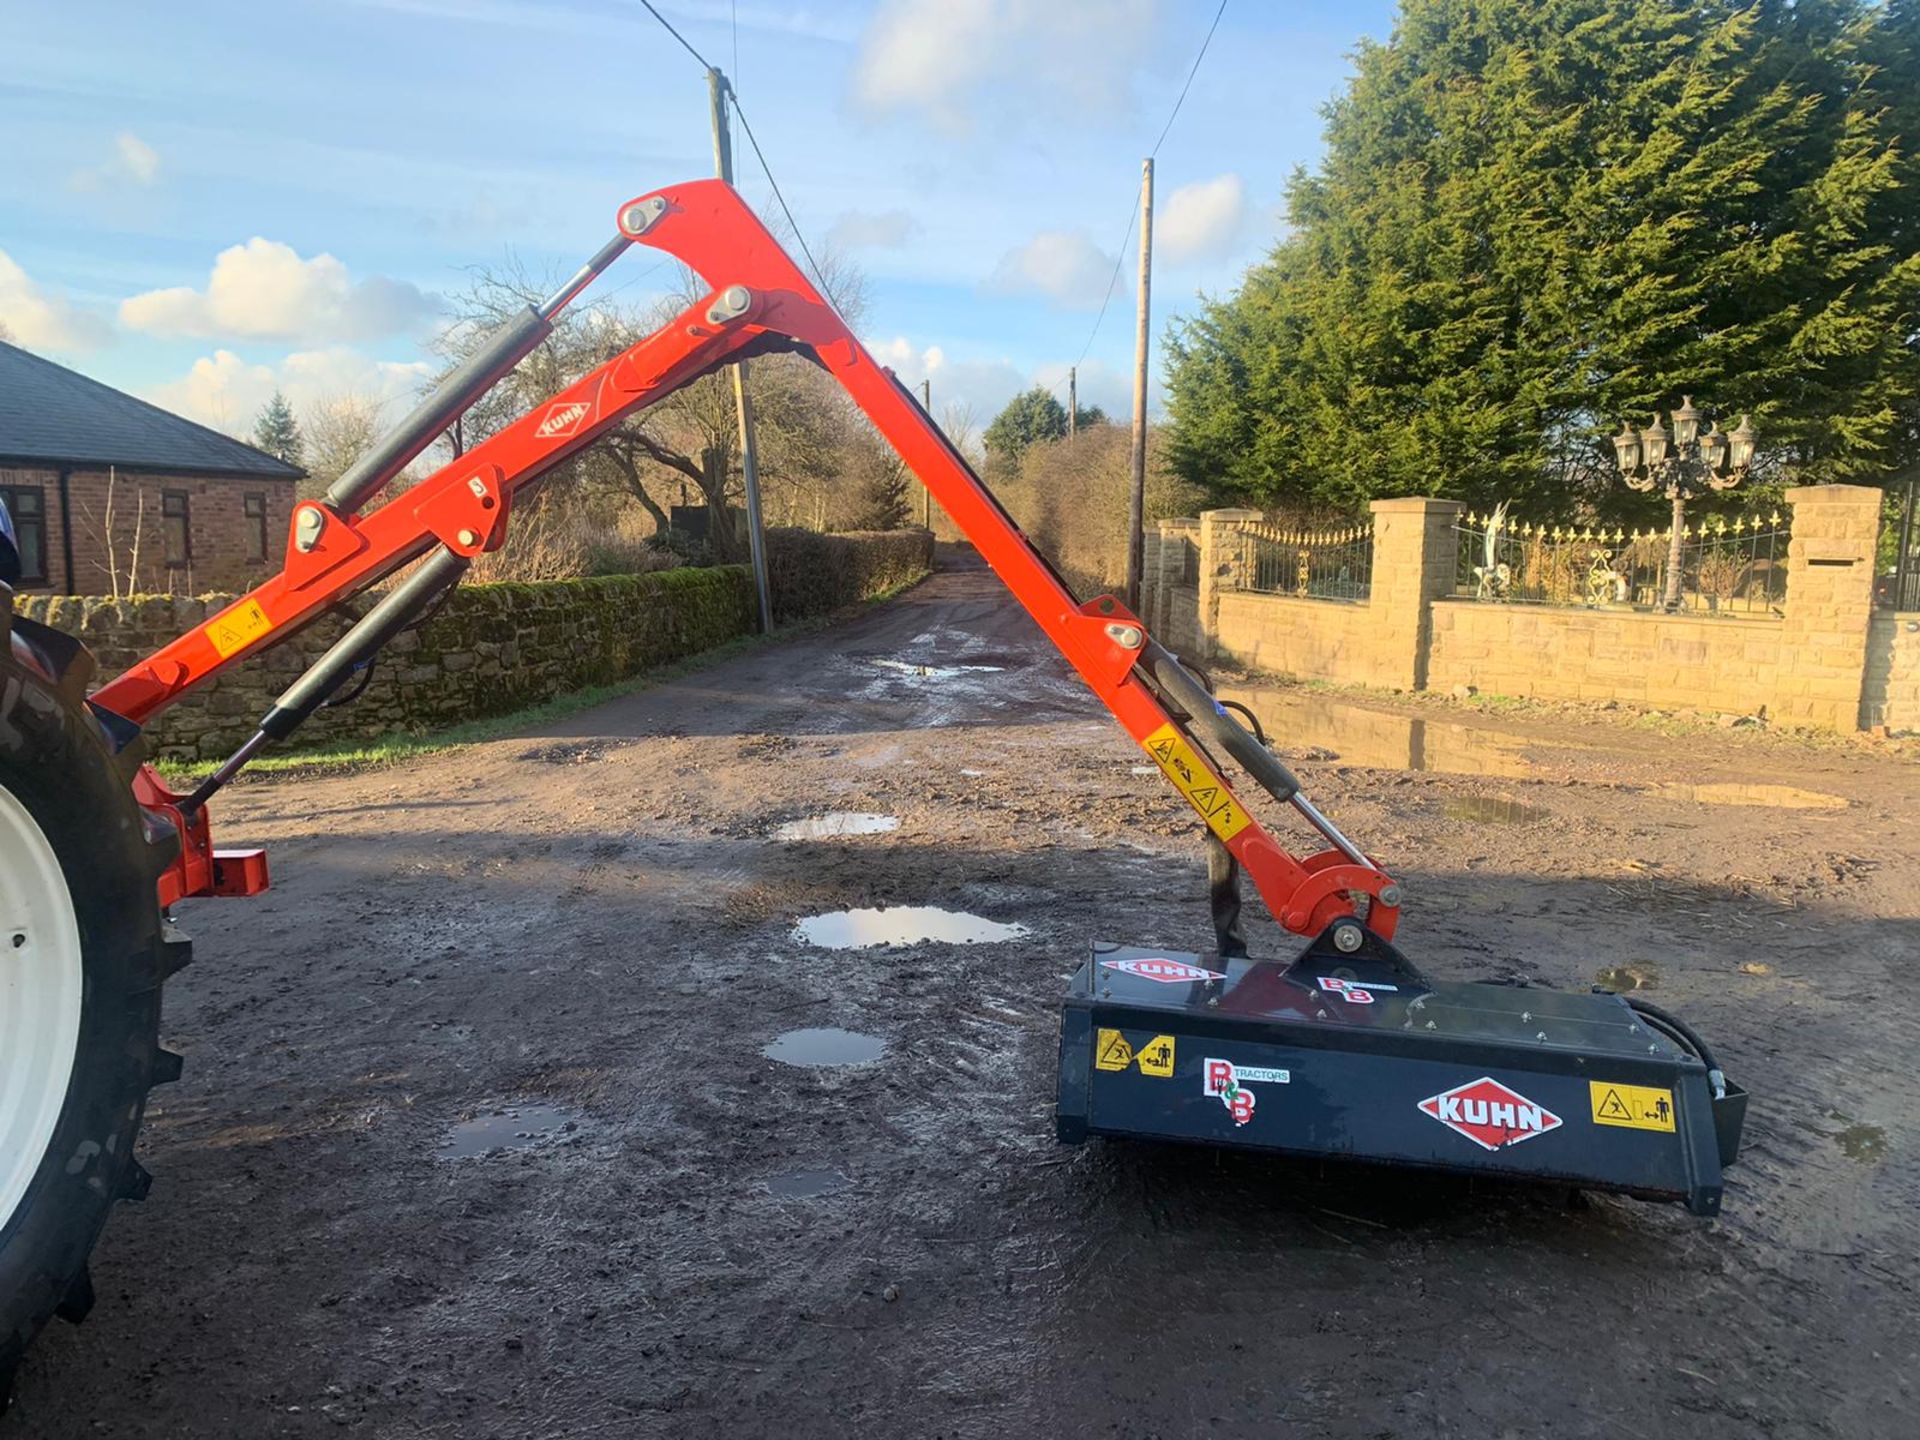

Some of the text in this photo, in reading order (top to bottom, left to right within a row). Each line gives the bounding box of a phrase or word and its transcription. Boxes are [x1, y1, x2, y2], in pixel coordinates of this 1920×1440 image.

[541, 403, 584, 435] KUHN
[1118, 961, 1210, 979] KUHN
[1235, 1068, 1288, 1081] TRACTORS
[1438, 1096, 1542, 1132] KUHN
